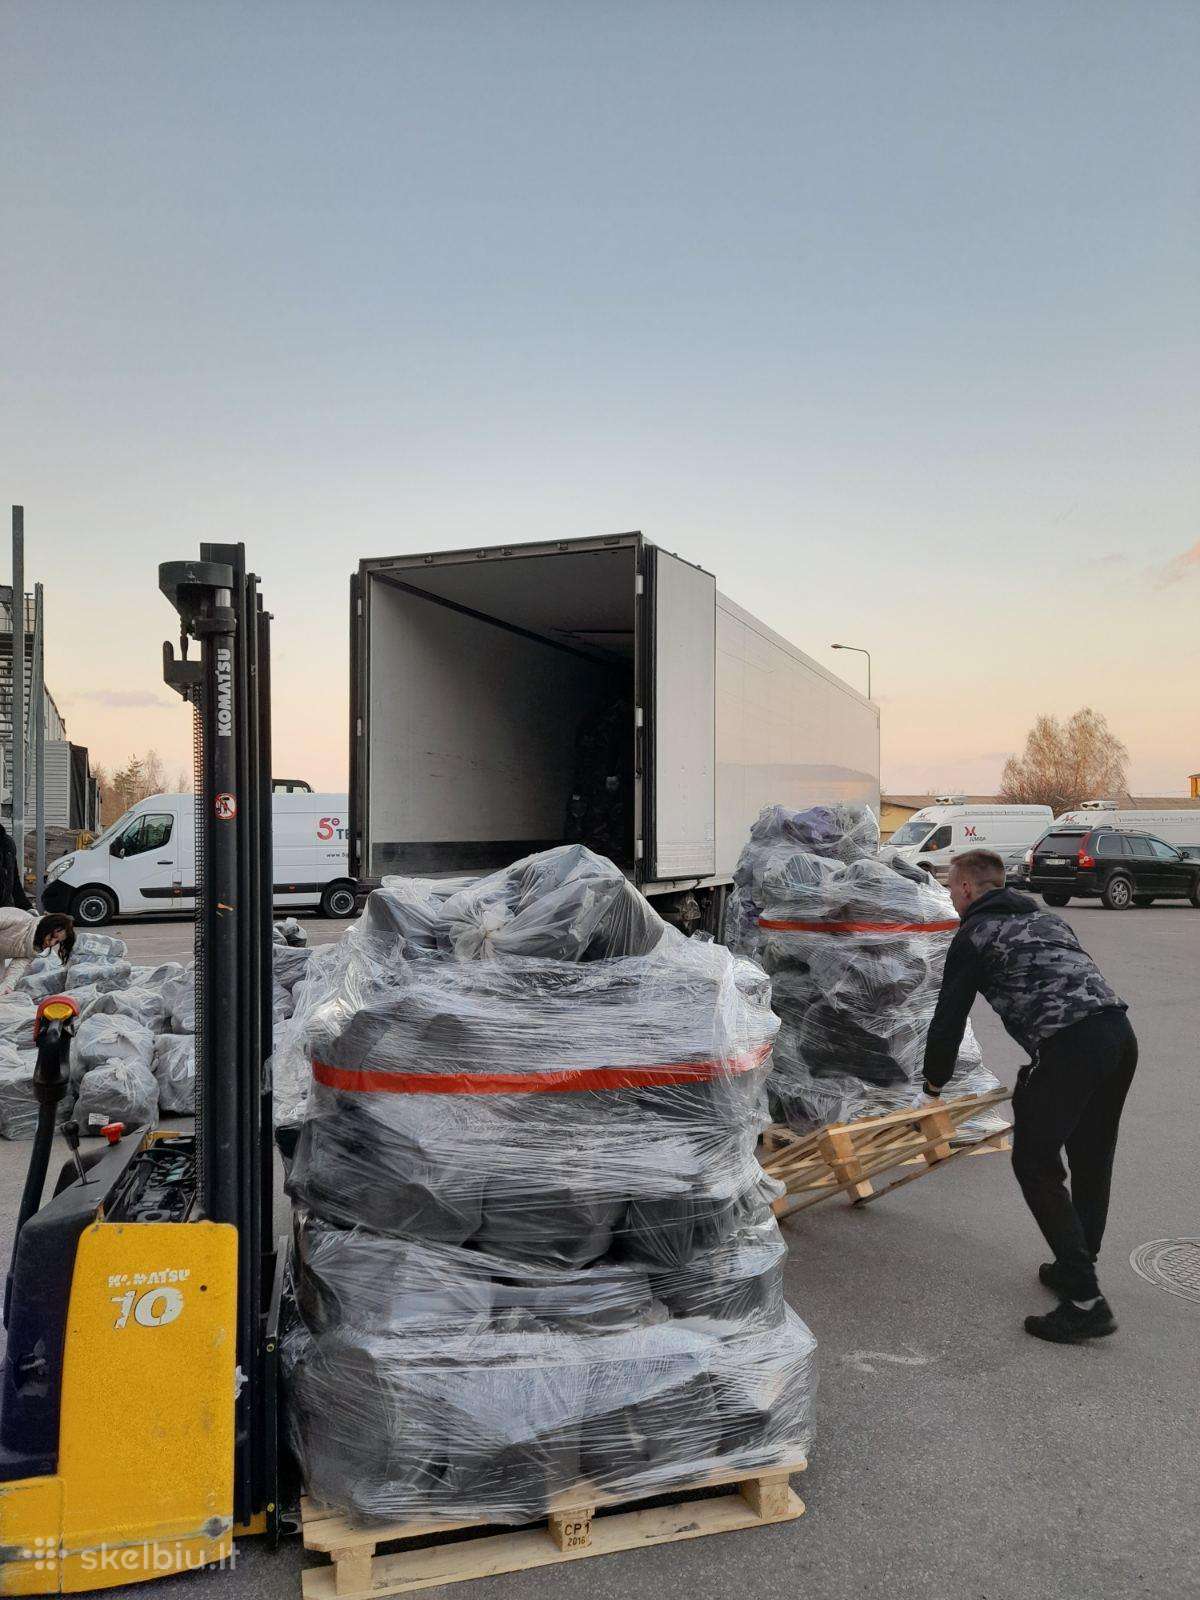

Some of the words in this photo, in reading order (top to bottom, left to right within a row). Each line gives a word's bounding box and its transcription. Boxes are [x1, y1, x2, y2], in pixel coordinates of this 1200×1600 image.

[215, 648, 232, 737] KOMATSU
[110, 1287, 185, 1329] 10
[567, 1536, 586, 1547] 2016
